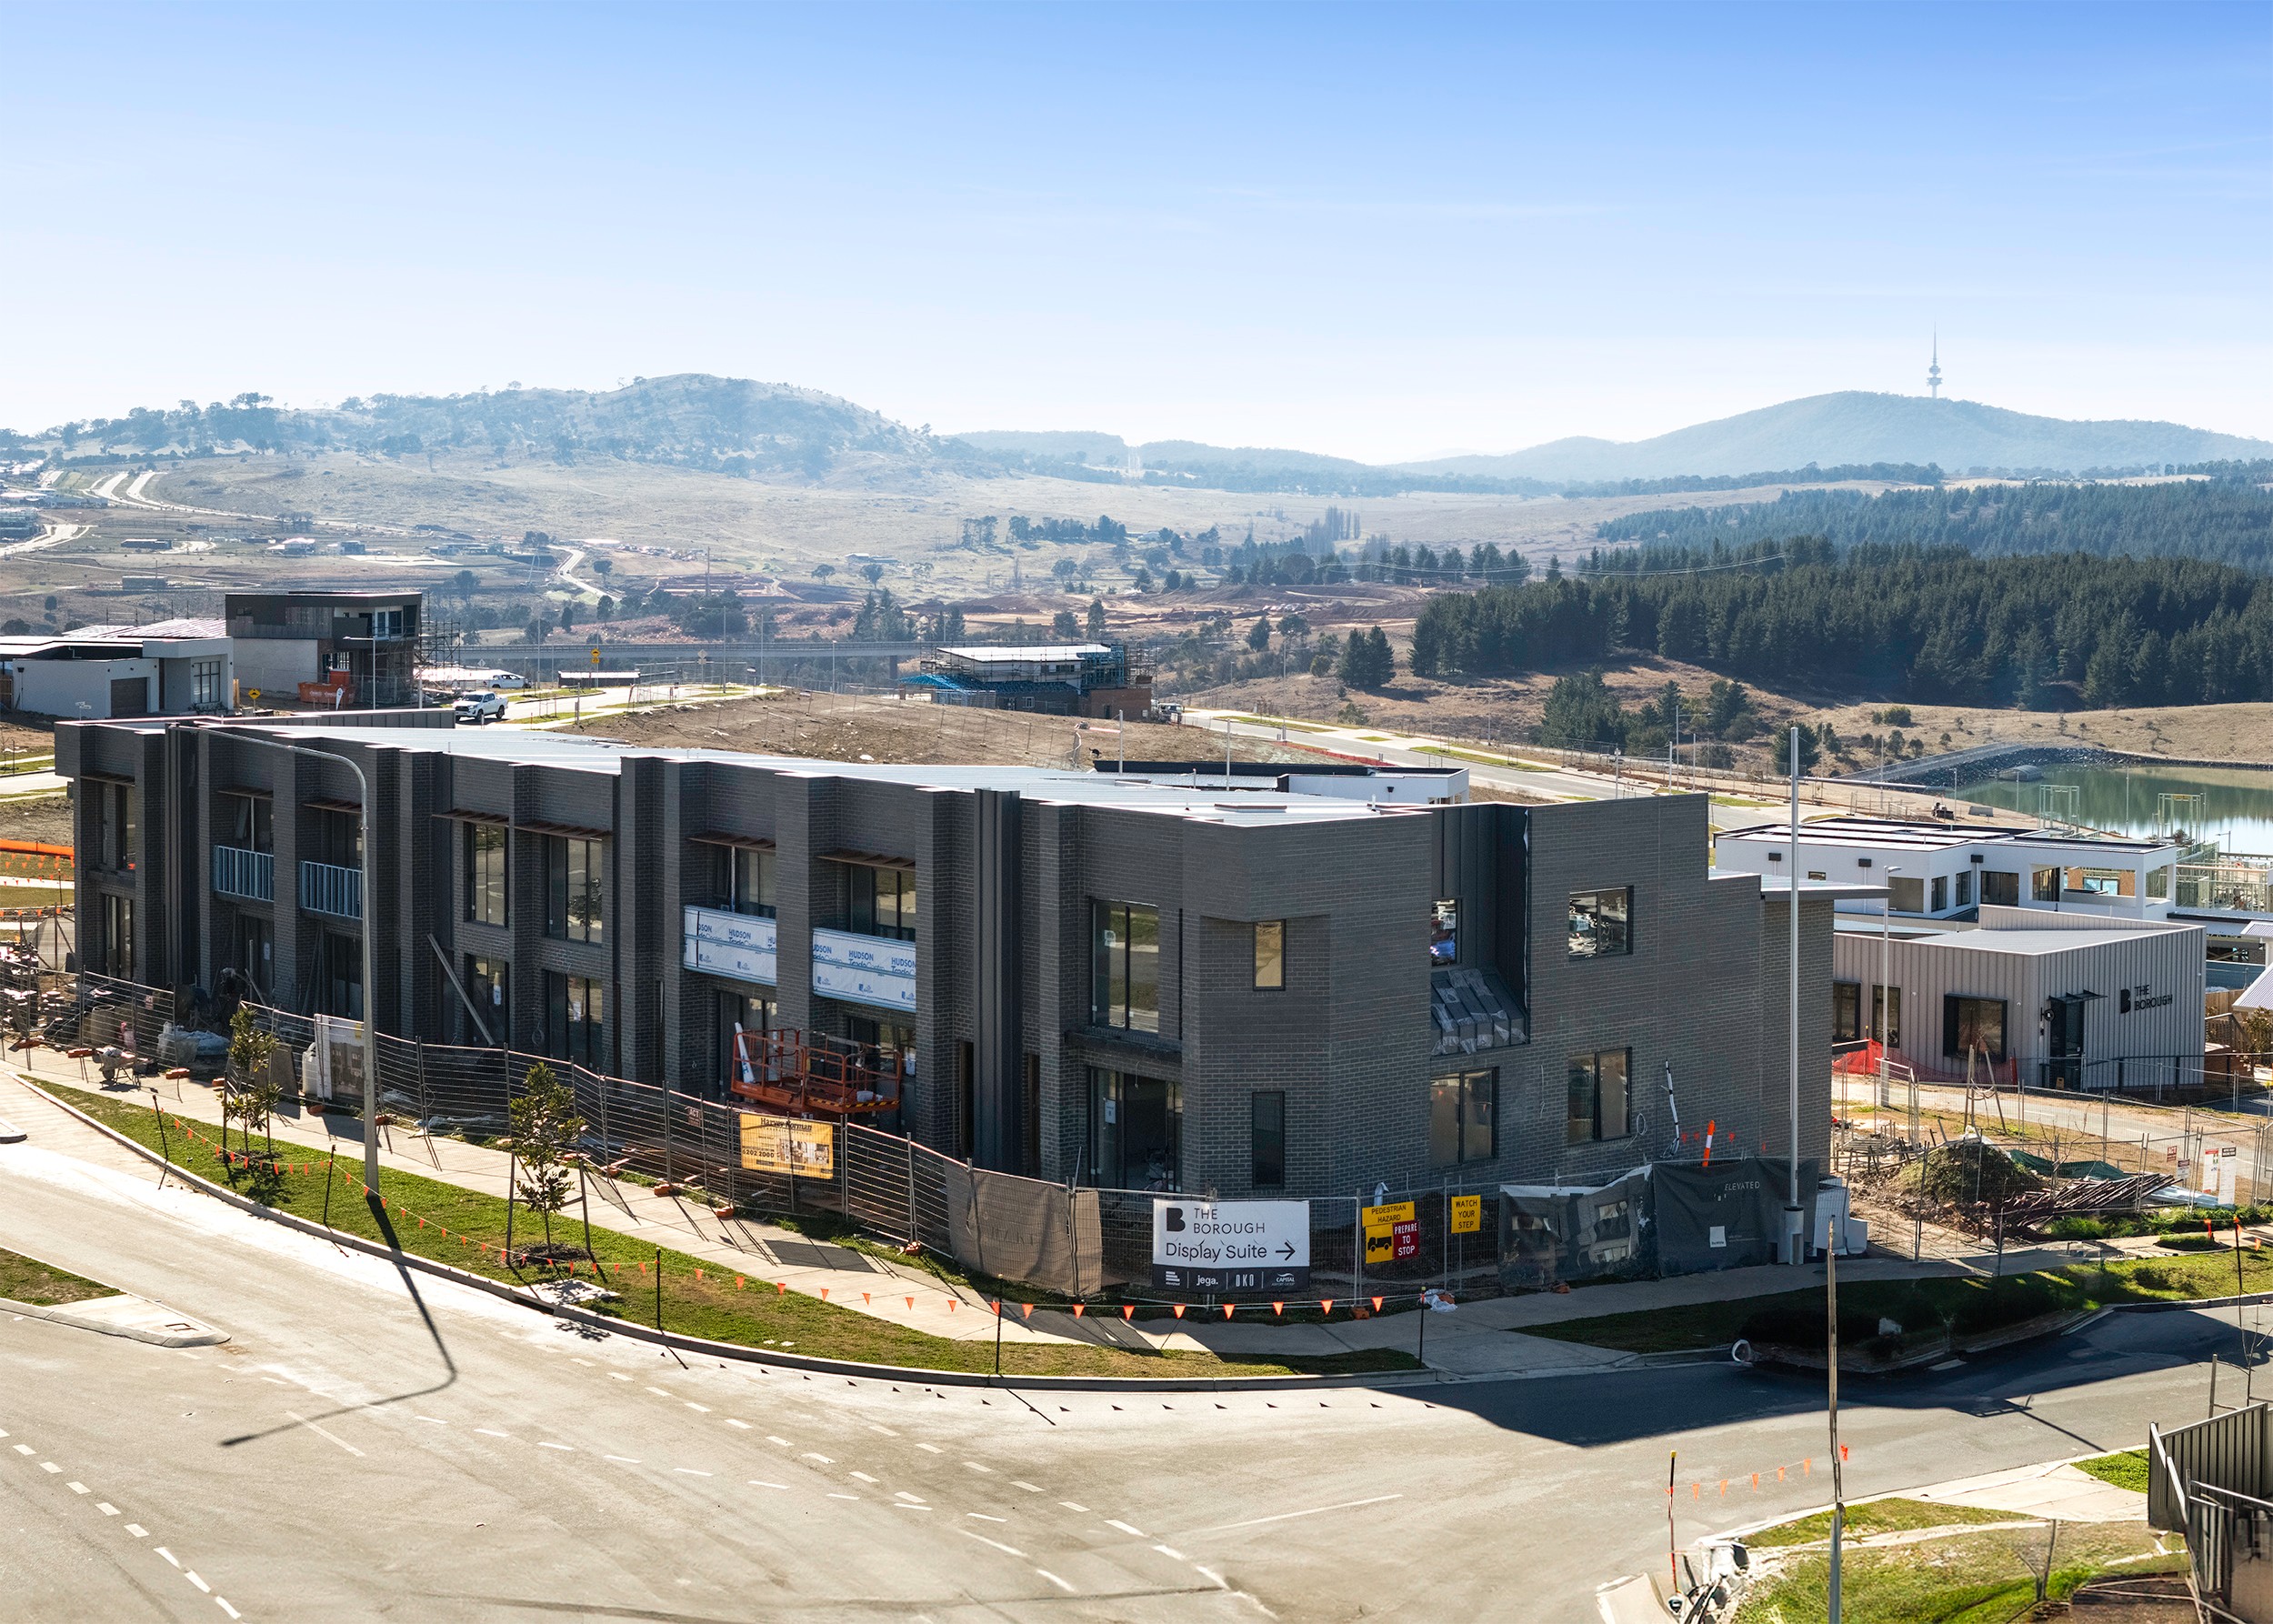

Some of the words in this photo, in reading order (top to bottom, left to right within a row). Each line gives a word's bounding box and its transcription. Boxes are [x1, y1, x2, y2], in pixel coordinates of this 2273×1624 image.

[728, 928, 751, 940] HUDSON
[848, 950, 874, 961] HUDSON
[2134, 985, 2150, 997] THE
[2134, 994, 2173, 1011] BOROUGH
[760, 1118, 784, 1128] Harvey
[786, 1119, 813, 1132] Norman
[758, 1149, 775, 1158] 2000
[1724, 1181, 1760, 1191] ELEVATED
[1456, 1199, 1477, 1208] WATCH
[1194, 1208, 1217, 1220] THE
[1371, 1205, 1407, 1215] PEDESTRIAN
[1457, 1210, 1476, 1218] YOUR
[1377, 1214, 1401, 1223] HAZARD
[1457, 1220, 1474, 1228] STEP
[1194, 1223, 1265, 1235] BOROUGH
[1394, 1223, 1417, 1235] PREPARE
[1402, 1235, 1411, 1244] TO
[1166, 1242, 1221, 1263] Display
[1226, 1244, 1267, 1258] Suite
[1397, 1245, 1416, 1256] STOP
[1197, 1275, 1218, 1287] jega.
